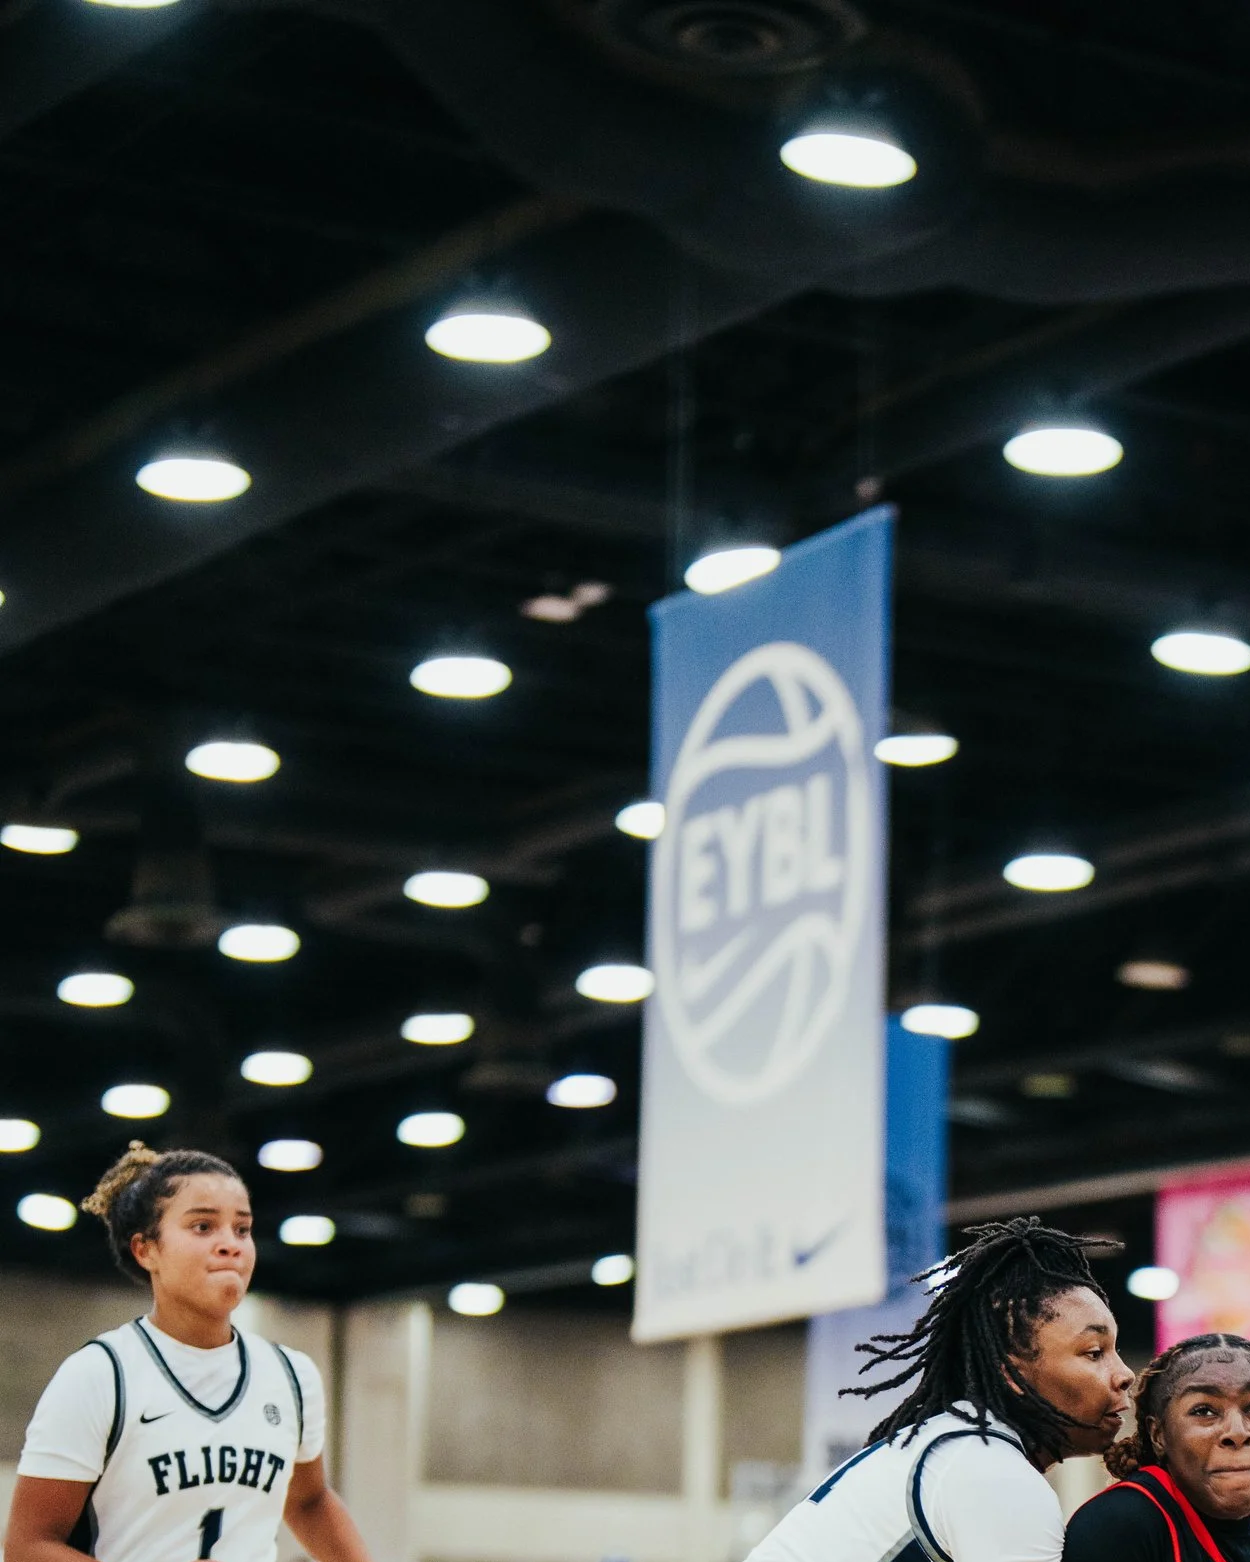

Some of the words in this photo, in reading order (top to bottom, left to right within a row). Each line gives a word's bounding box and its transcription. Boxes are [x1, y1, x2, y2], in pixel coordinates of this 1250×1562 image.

[679, 774, 843, 931] EYBL
[148, 1446, 285, 1496] FLIGHT
[198, 1507, 225, 1560] 1
